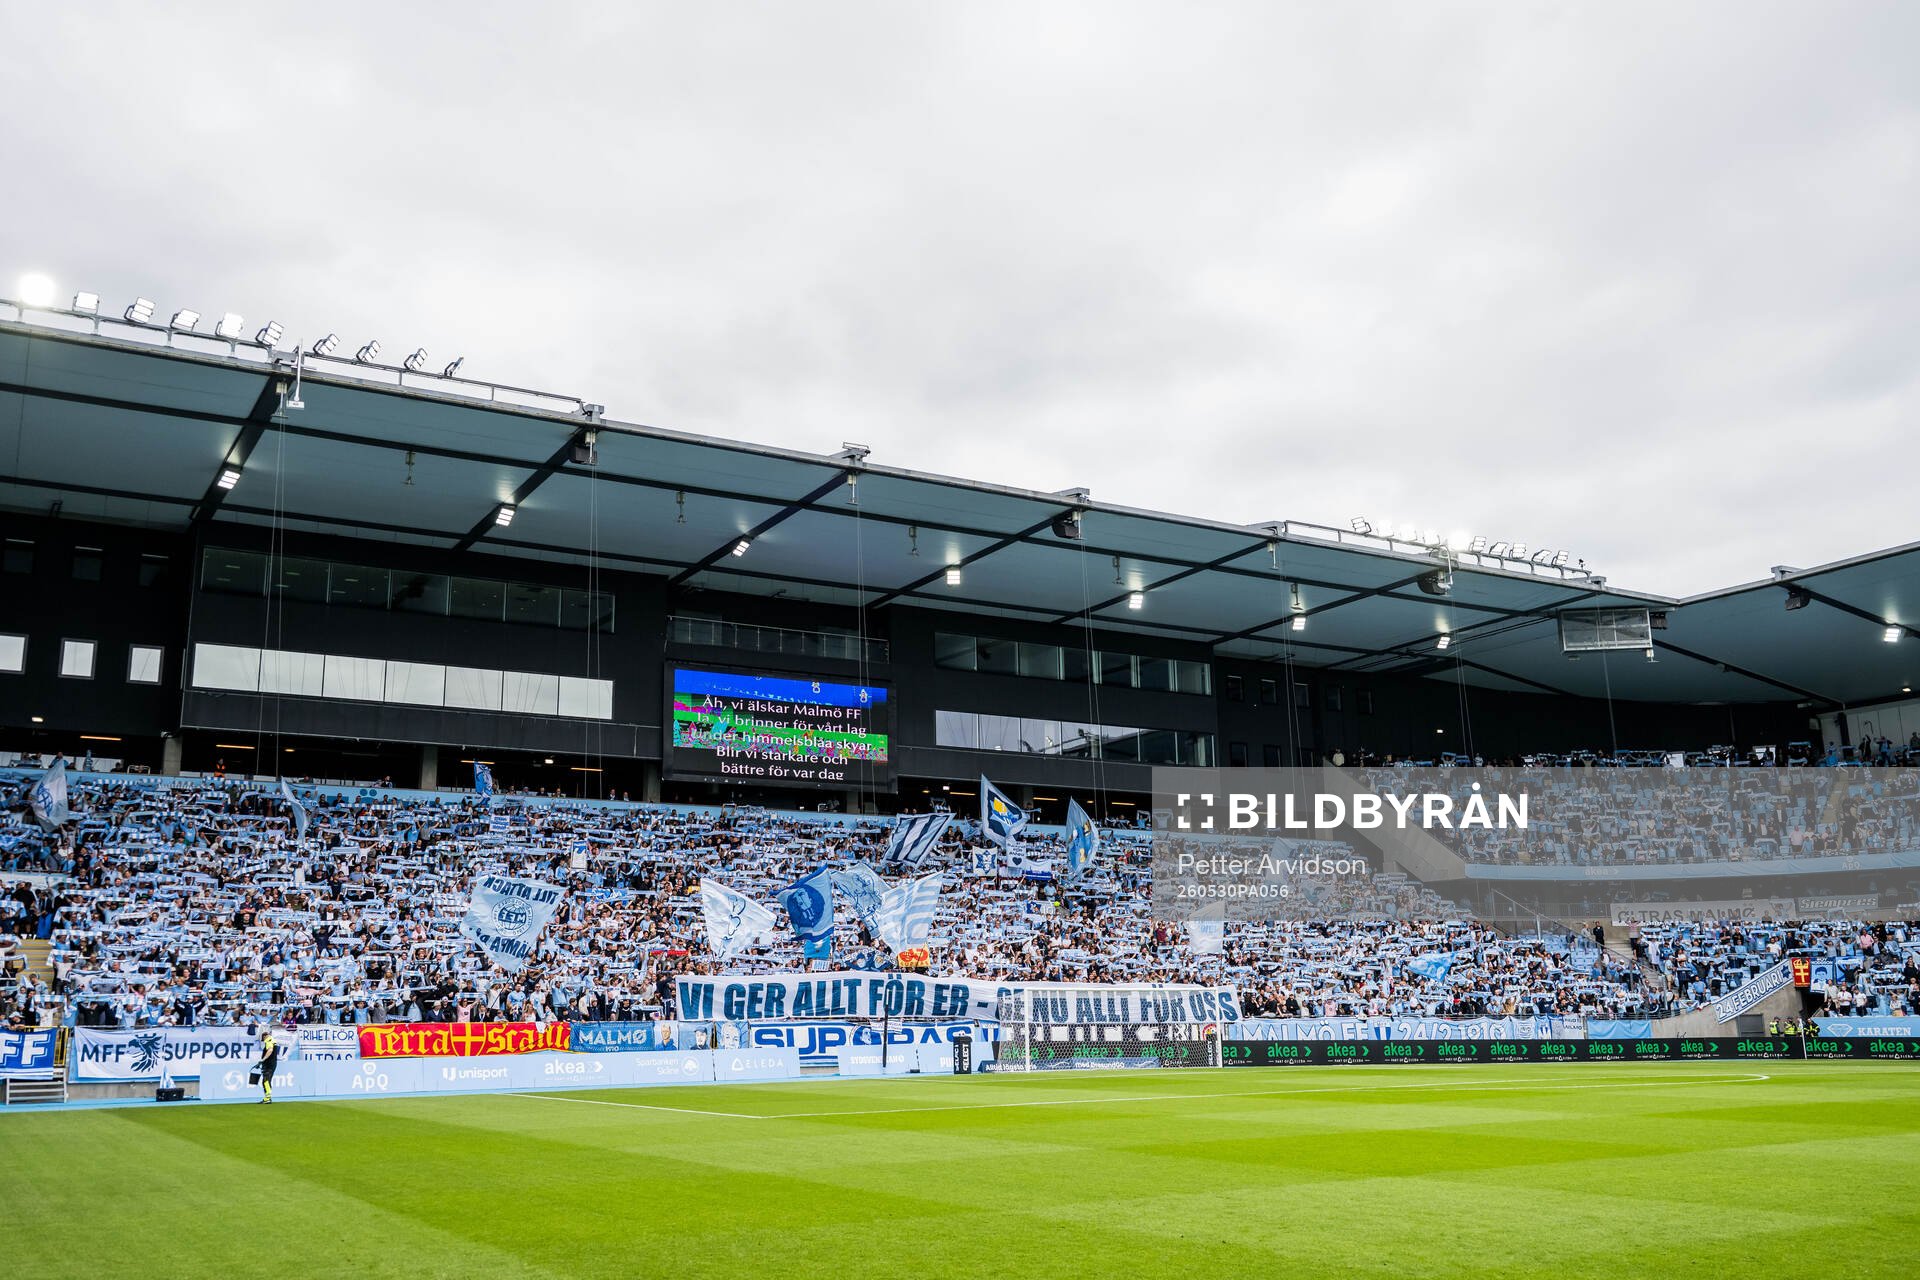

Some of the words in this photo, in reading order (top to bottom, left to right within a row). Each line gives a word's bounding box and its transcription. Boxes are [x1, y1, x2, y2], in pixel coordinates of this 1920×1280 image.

[703, 694, 727, 710] Åh,
[731, 700, 744, 710] vi
[748, 701, 790, 714] älskar
[793, 704, 842, 718] Malmö
[846, 708, 862, 719] FF
[718, 714, 730, 724] vi
[735, 715, 789, 729] brinner
[793, 720, 813, 731] för
[817, 721, 843, 733] vårt
[847, 723, 867, 738] lag
[716, 745, 742, 757] Blir
[745, 749, 757, 759] vi
[761, 751, 819, 763] starkare
[822, 753, 848, 765] och
[721, 761, 765, 776] bättre
[769, 765, 790, 777] för
[793, 769, 815, 779] var
[818, 768, 844, 780] dag
[679, 982, 714, 1020] VI
[724, 982, 787, 1020] GER
[793, 979, 862, 1017] ALLT
[869, 973, 926, 1016] FÖR
[932, 984, 970, 1016] ER
[1032, 991, 1069, 1022] NU
[1076, 991, 1133, 1022] ALLT
[1139, 984, 1186, 1022] FÖR
[1189, 991, 1239, 1022] OSS
[1716, 1000, 1733, 1018] 24
[1731, 971, 1784, 1011] FEBRUARI
[332, 1026, 354, 1041] FÖR
[1857, 1027, 1912, 1036] KARATEN
[360, 1026, 449, 1055] Terra
[1589, 1041, 1613, 1054] akea
[1635, 1040, 1660, 1053] akea
[1680, 1040, 1704, 1053] akea
[1737, 1039, 1774, 1052] akea
[1806, 1039, 1838, 1052] akea
[1870, 1039, 1905, 1053] akea
[80, 1044, 126, 1063] MFF
[163, 1042, 254, 1060] SUPPORT
[1223, 1046, 1238, 1057] ea
[1267, 1043, 1298, 1057] akea
[1327, 1043, 1357, 1057] akea
[1384, 1042, 1412, 1056] akea
[1438, 1042, 1466, 1056] akea
[1490, 1041, 1517, 1055] akea
[1540, 1041, 1566, 1055] akea
[459, 1066, 508, 1081] unisport
[544, 1059, 585, 1075] akea
[352, 1074, 389, 1091] ApQ
